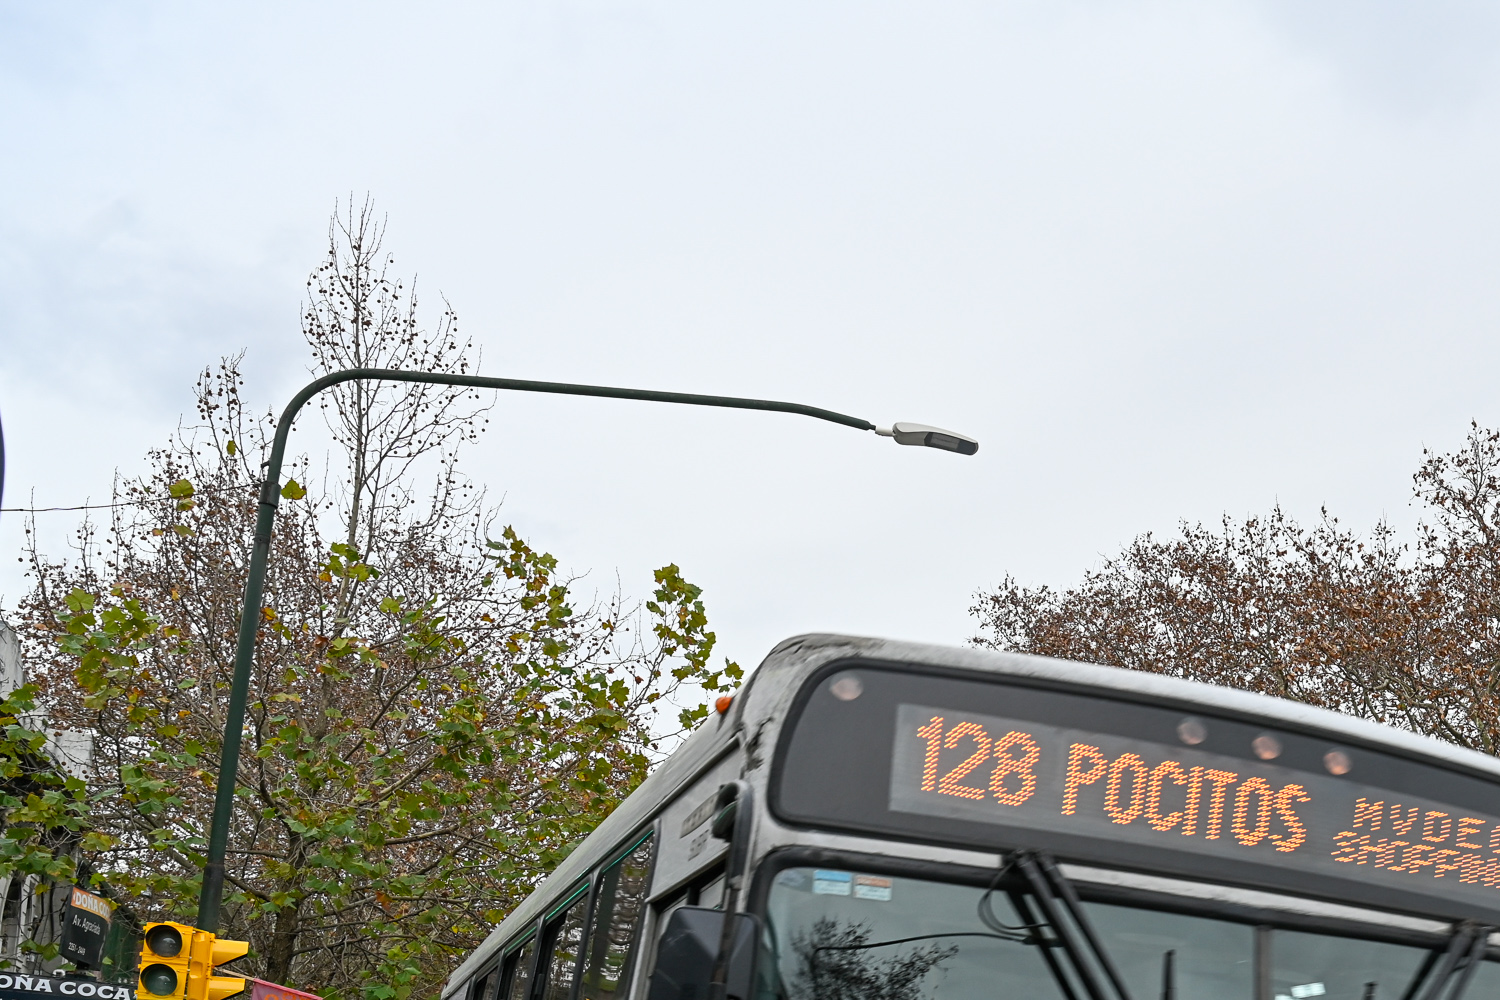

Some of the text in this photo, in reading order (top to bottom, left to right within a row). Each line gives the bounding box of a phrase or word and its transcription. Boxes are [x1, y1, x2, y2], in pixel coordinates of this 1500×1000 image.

[916, 716, 1311, 853] 128 POCITOS
[72, 914, 101, 935] Av. Agraciada
[0, 974, 131, 1000] OÑA COCA
